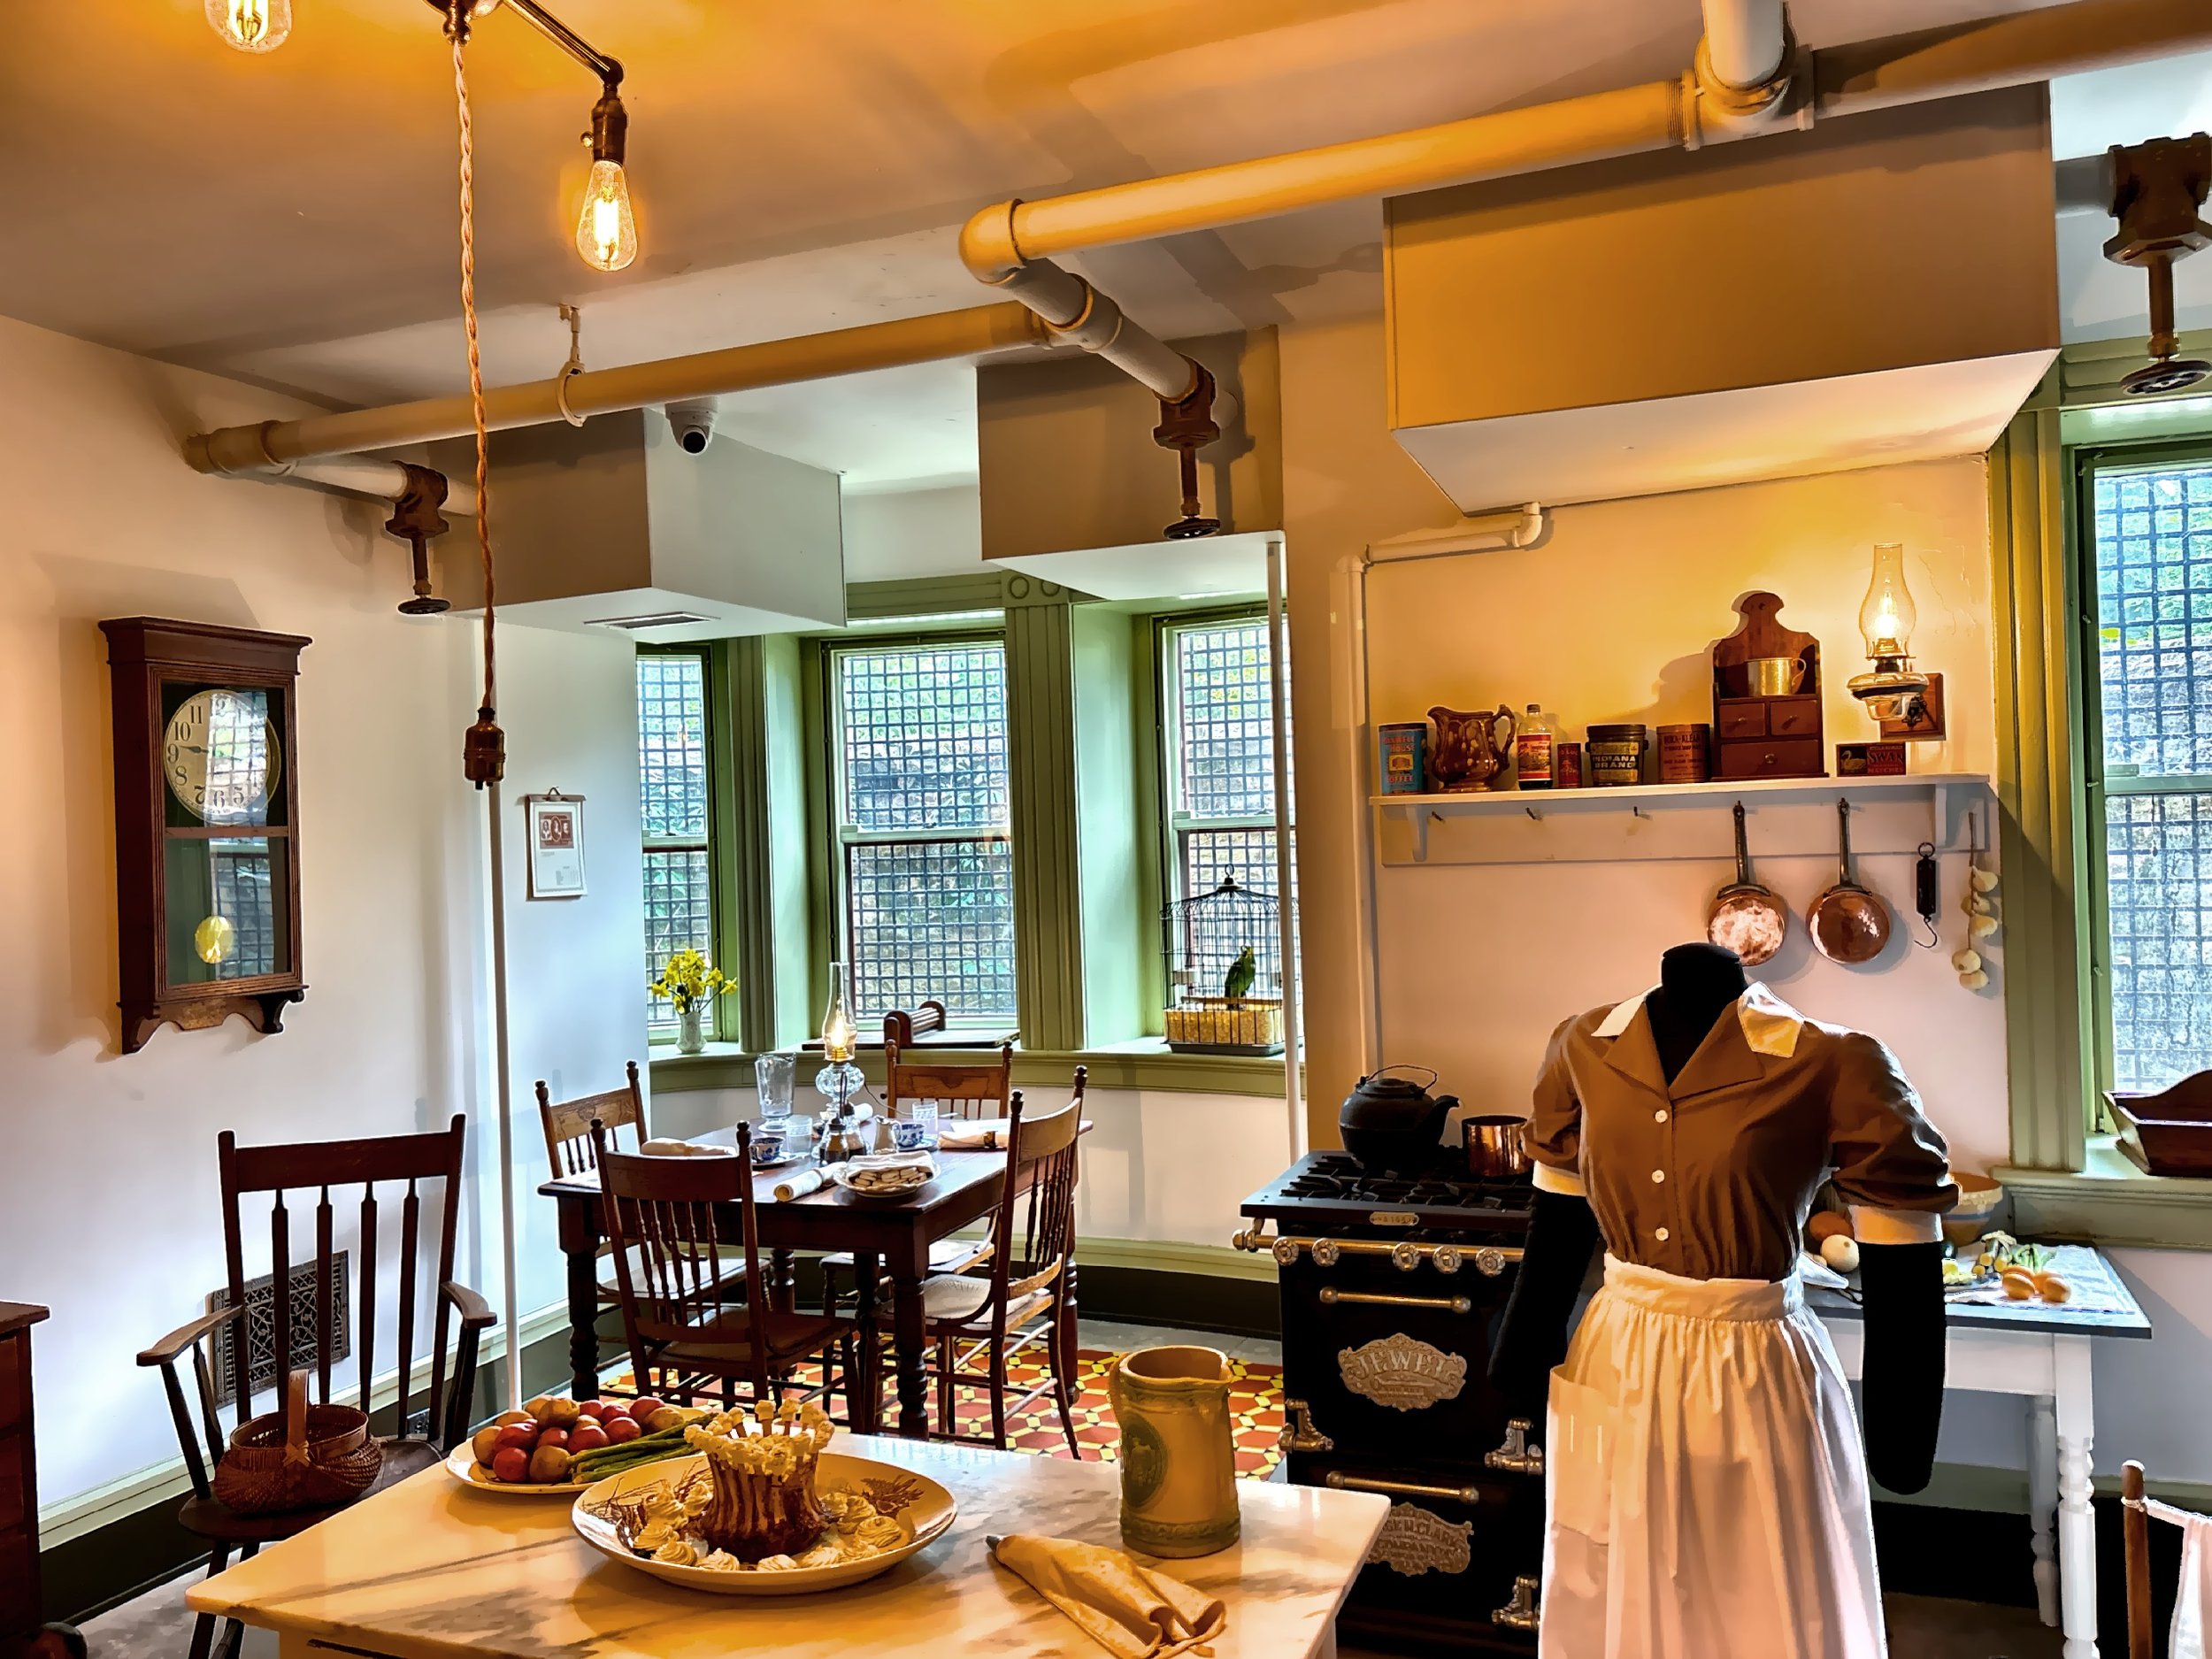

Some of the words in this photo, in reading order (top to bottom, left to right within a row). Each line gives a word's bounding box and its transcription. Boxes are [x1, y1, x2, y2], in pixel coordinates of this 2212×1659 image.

[189, 705, 203, 724] 11
[173, 721, 191, 741] 10
[167, 743, 179, 764] 9
[1867, 751, 1904, 764] SWAN
[175, 765, 187, 786] 8
[194, 785, 206, 804] 7
[213, 790, 226, 808] 6
[234, 786, 245, 805] 5
[1354, 1350, 1451, 1379] JEWEL
